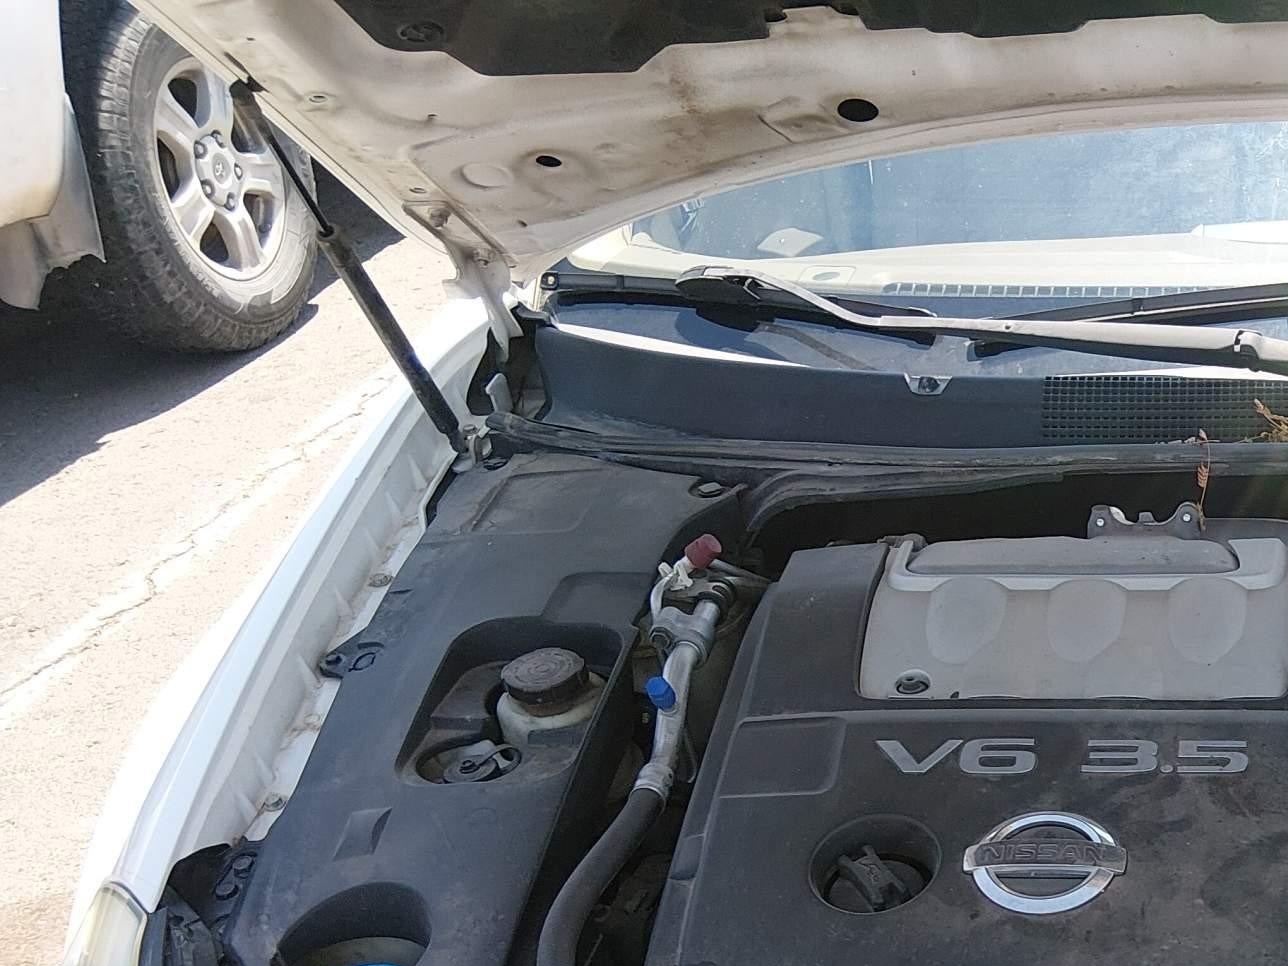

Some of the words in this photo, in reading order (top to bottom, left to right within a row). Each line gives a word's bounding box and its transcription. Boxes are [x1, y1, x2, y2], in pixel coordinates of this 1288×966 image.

[875, 738, 1037, 775] V6
[1080, 739, 1249, 775] 3.5
[981, 842, 1107, 863] NISSAN
